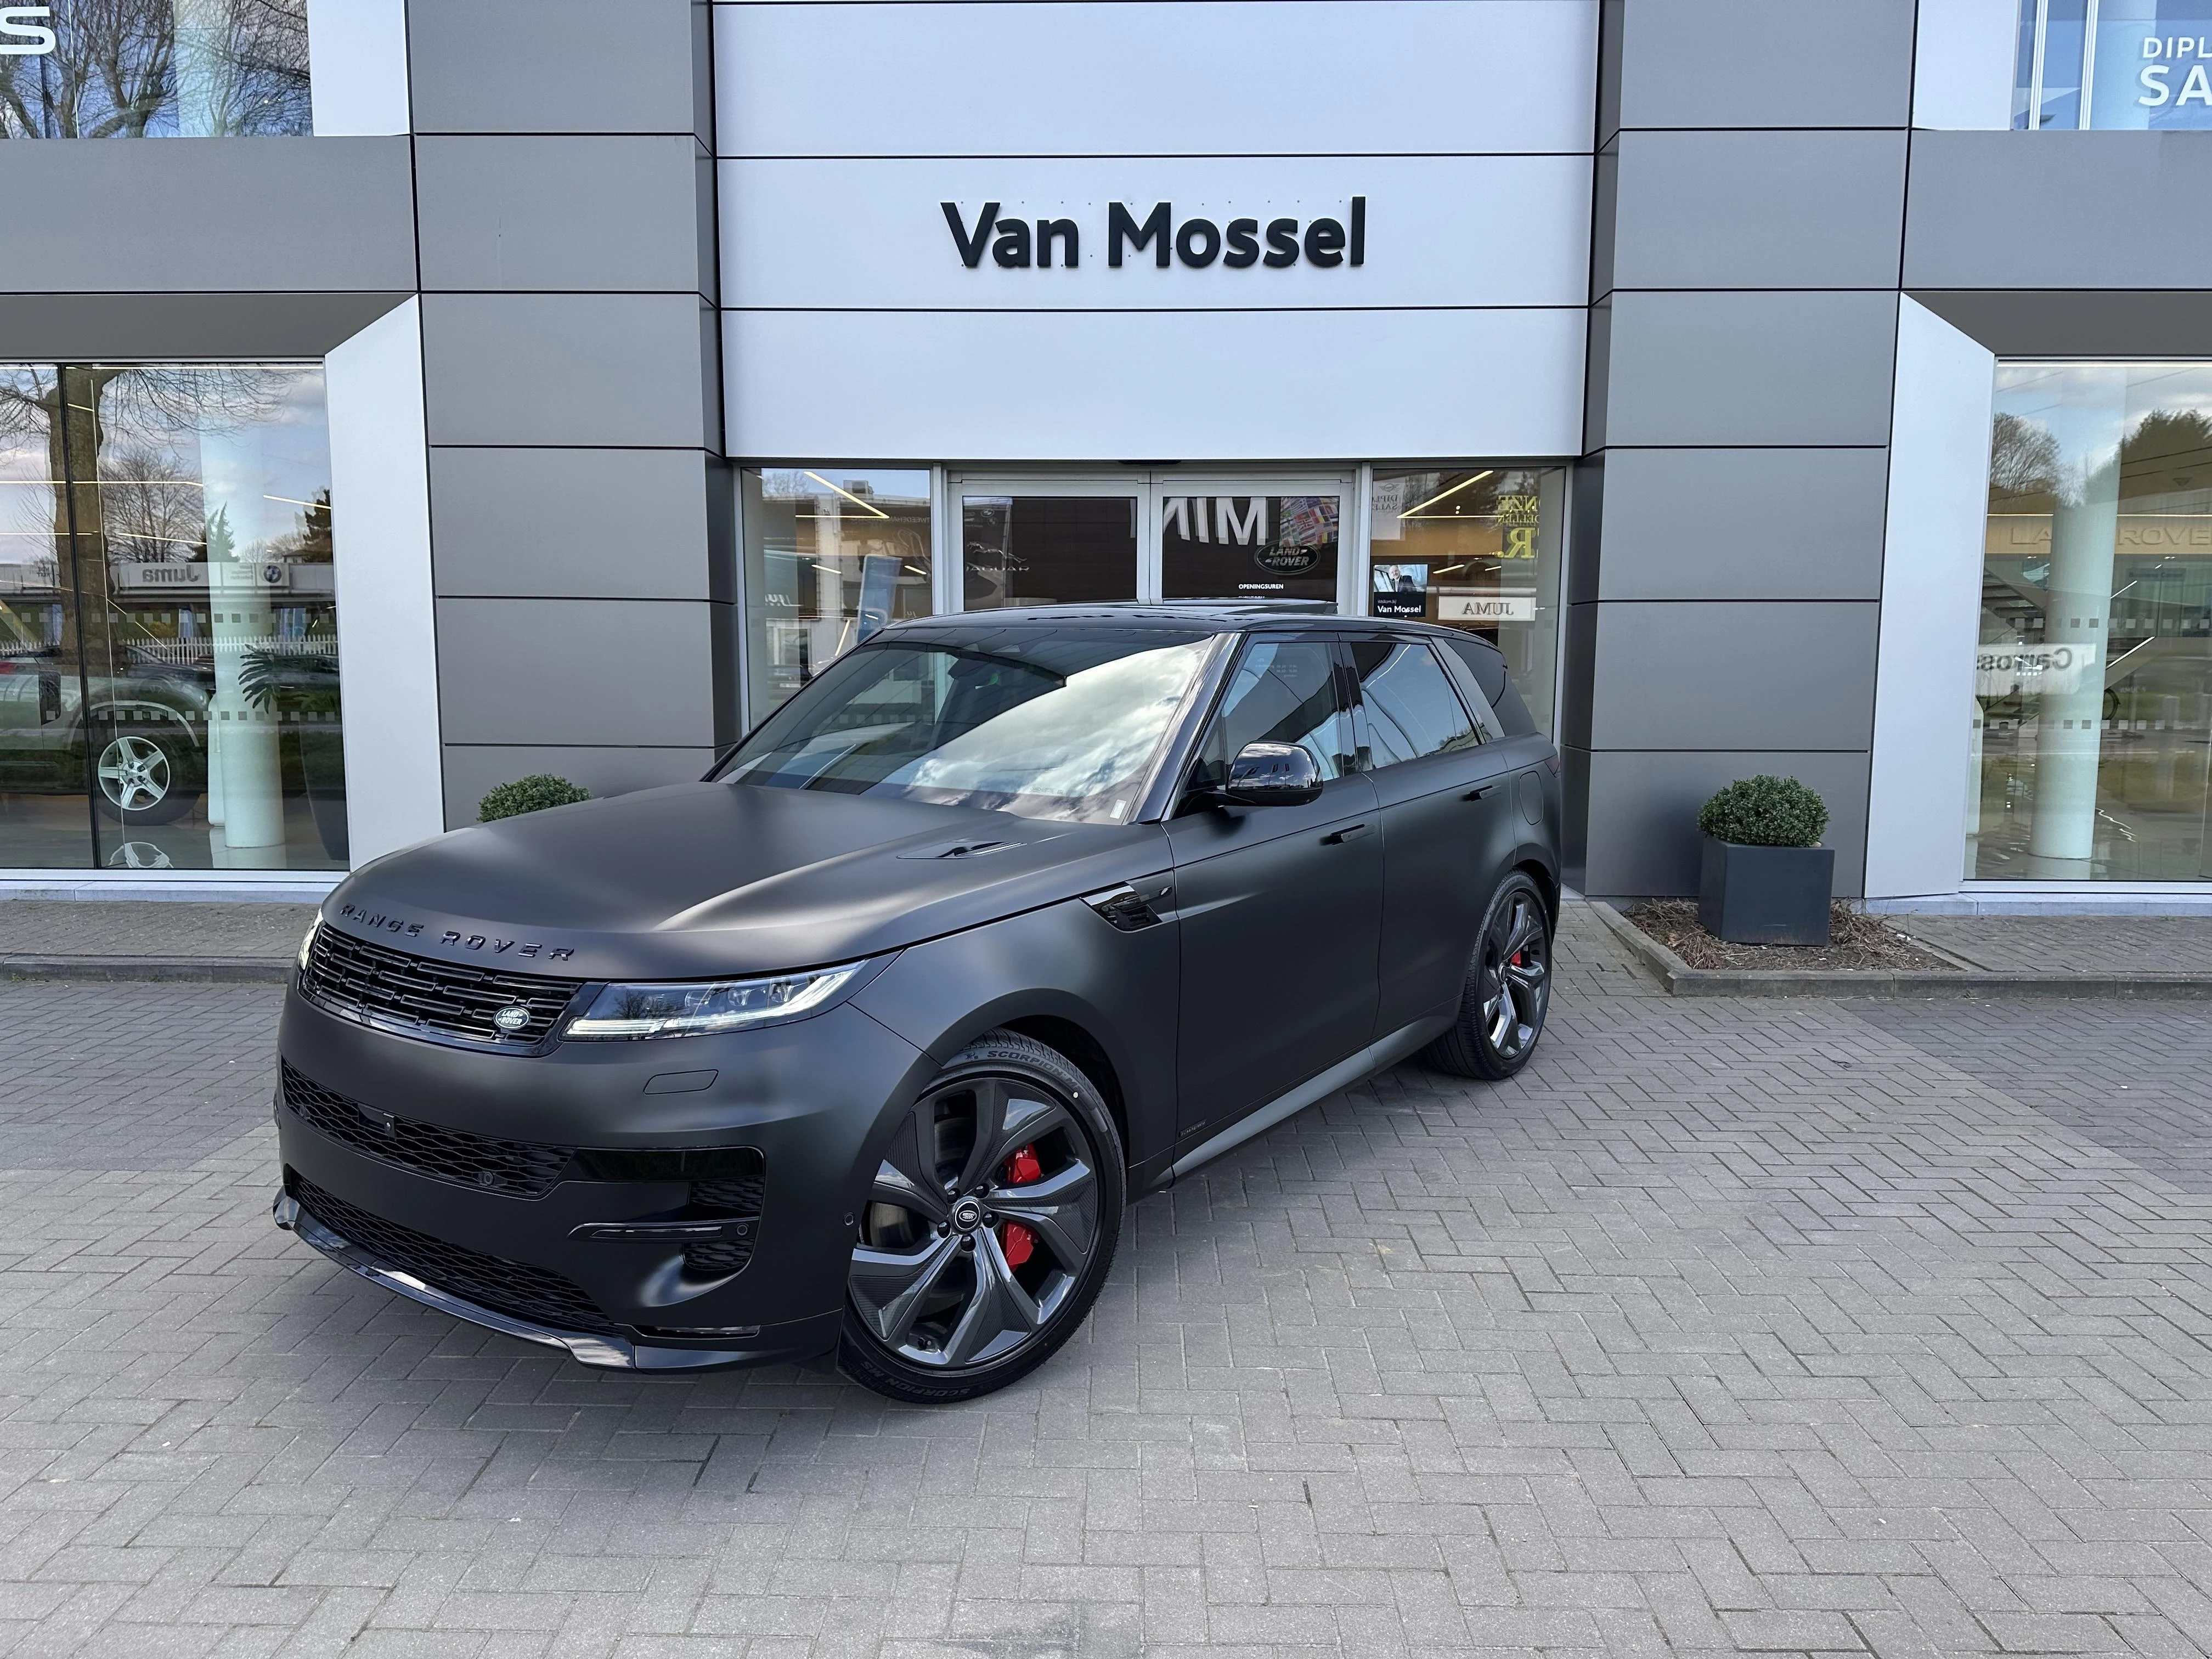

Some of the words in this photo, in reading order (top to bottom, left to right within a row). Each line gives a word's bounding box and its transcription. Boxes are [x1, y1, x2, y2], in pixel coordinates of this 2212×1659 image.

[0, 6, 56, 55] S
[940, 201, 1079, 268] Van
[1108, 196, 1366, 268] Mossel
[1269, 546, 1300, 556] LAND
[1271, 556, 1310, 566] ROVER
[1394, 605, 1421, 613] Mossel
[340, 903, 424, 937] RANGE
[439, 930, 575, 961] ROVER
[500, 1017, 523, 1025] ROVER
[988, 1051, 1063, 1077] SCORPION
[885, 1378, 970, 1397] SCORPION
